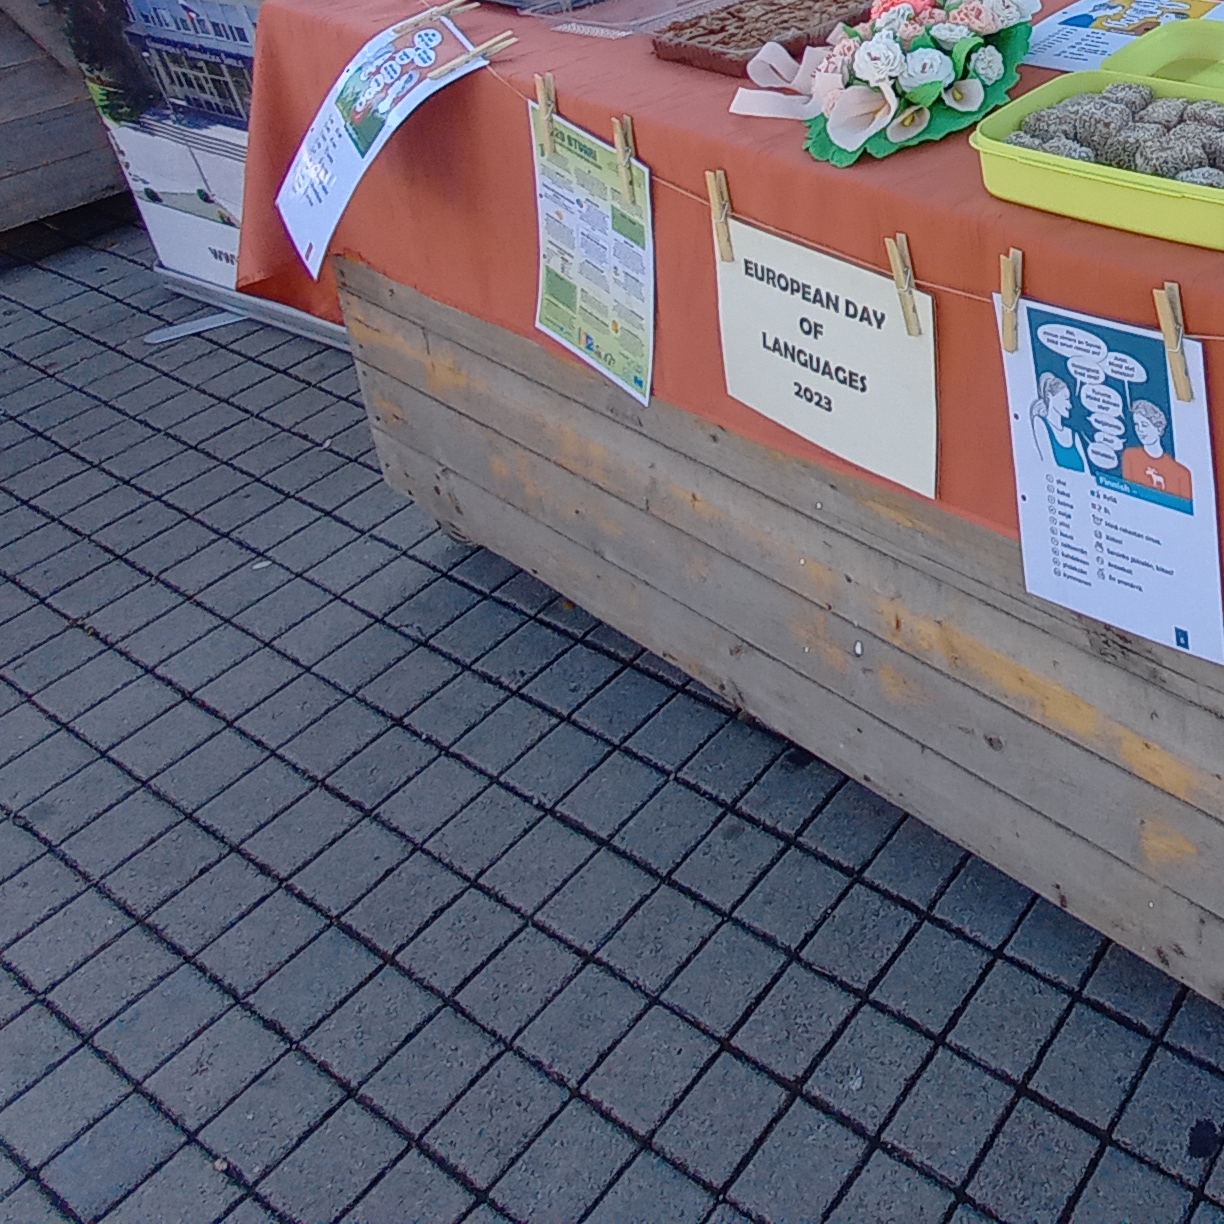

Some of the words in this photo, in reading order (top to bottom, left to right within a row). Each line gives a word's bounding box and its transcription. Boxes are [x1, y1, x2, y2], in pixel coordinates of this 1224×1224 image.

[744, 258, 839, 314] EUROPEAN
[844, 299, 886, 330] DAY
[799, 317, 824, 340] OF
[761, 331, 868, 393] LANGUAGES
[793, 381, 833, 413] 2023
[1100, 476, 1131, 493] Finnish
